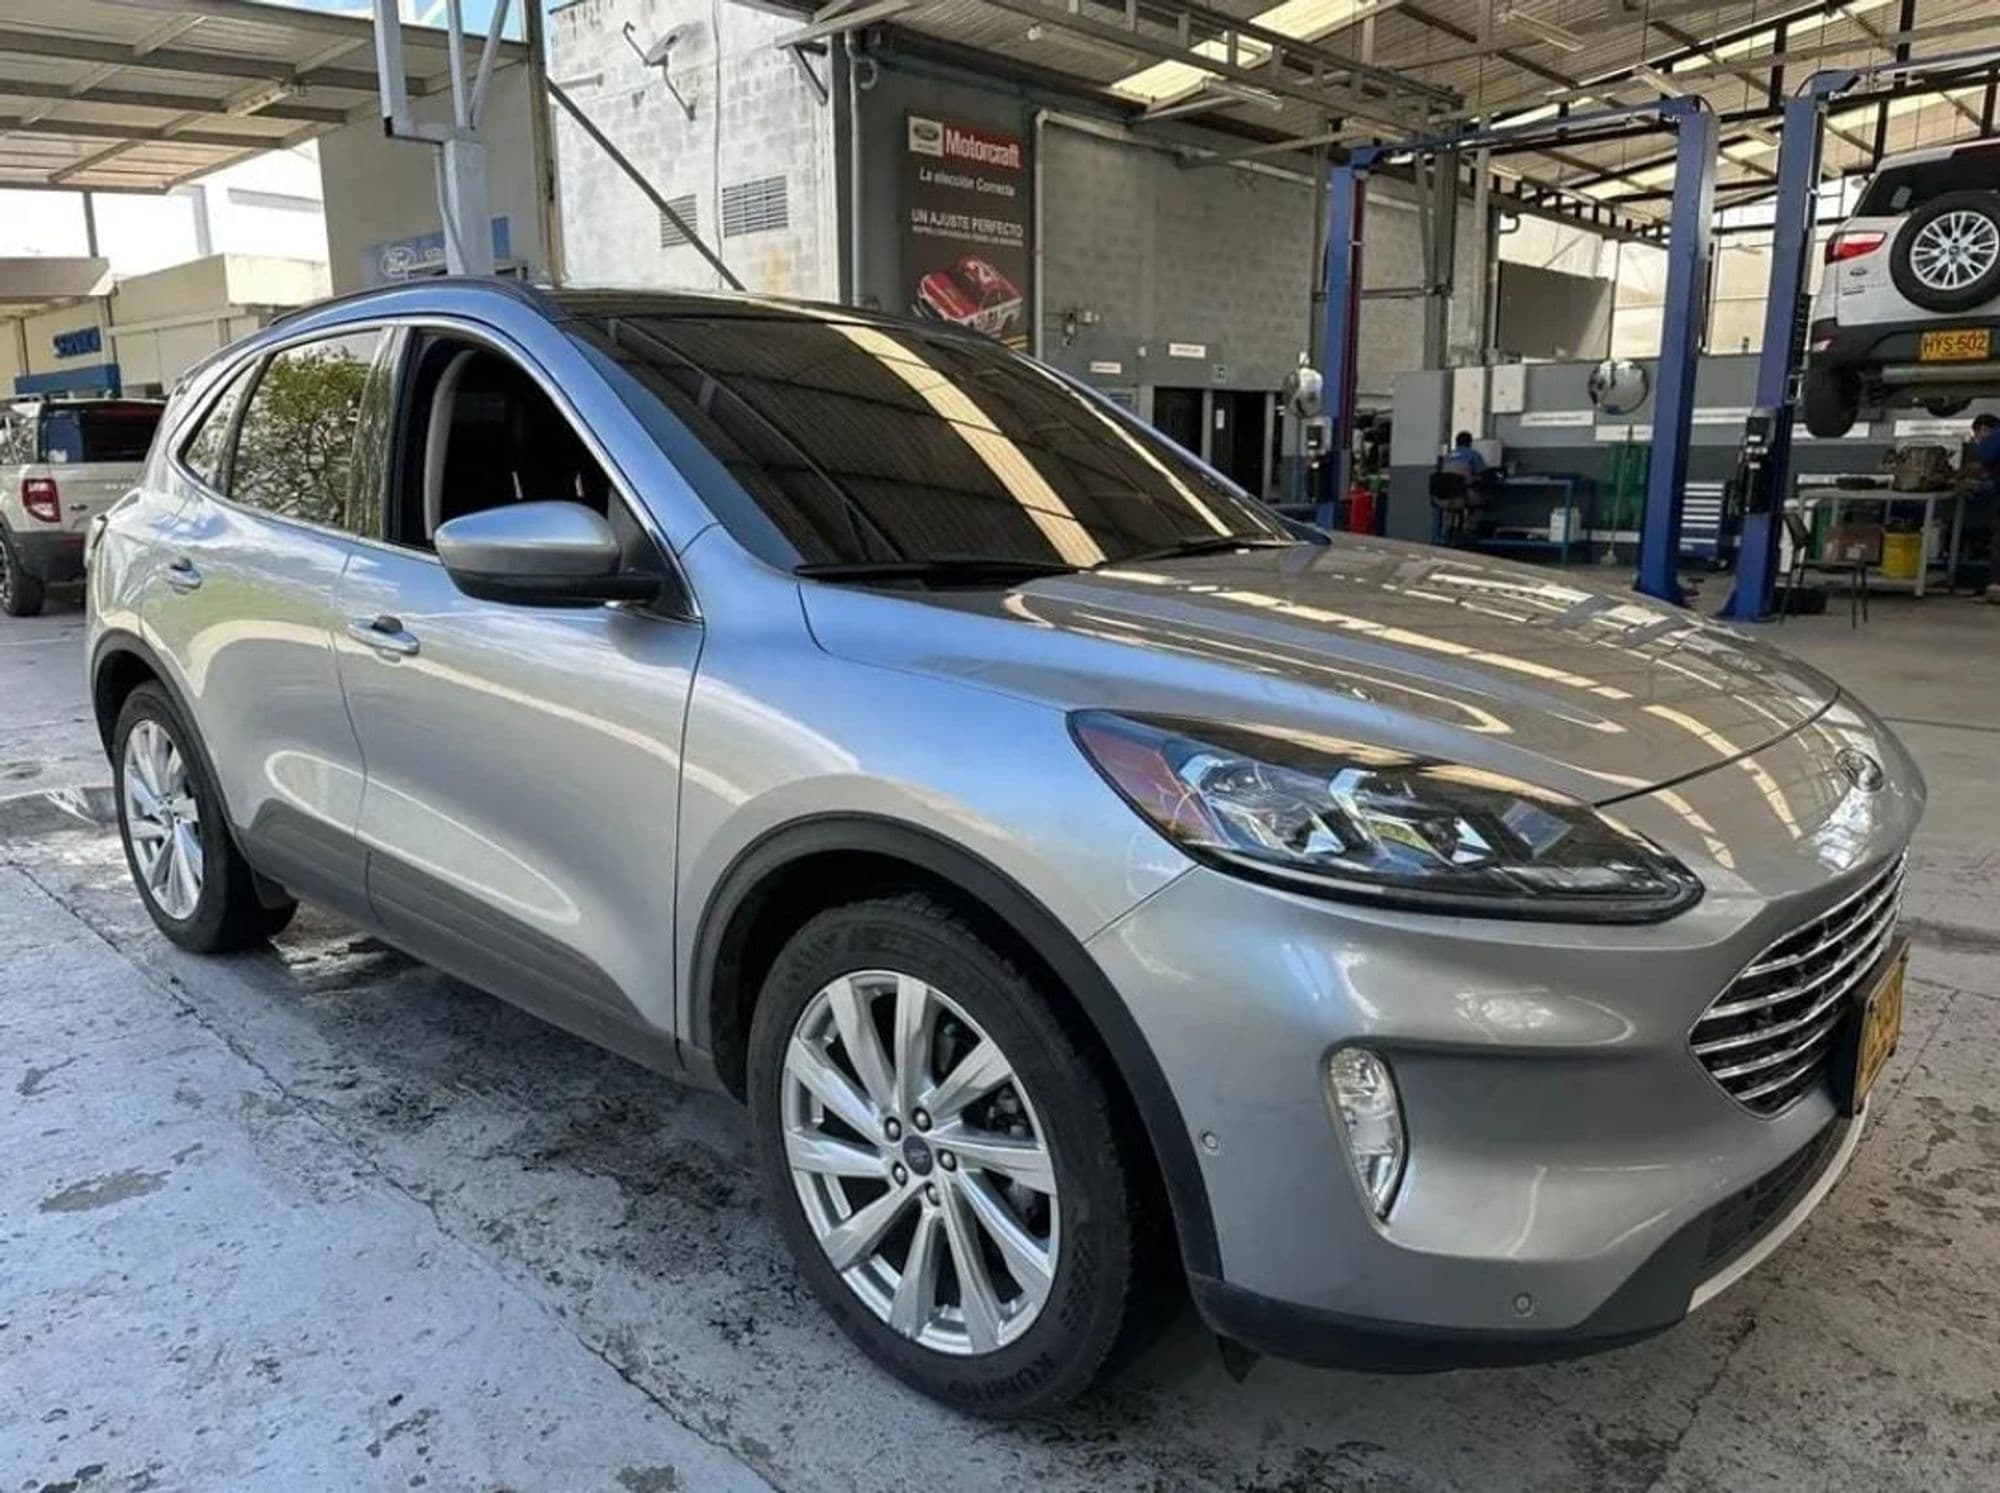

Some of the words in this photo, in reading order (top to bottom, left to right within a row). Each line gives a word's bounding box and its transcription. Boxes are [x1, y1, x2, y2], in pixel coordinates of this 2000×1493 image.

[945, 128, 1020, 168] Motorcraft
[911, 208, 927, 223] UN
[930, 211, 969, 229] AJUSTE
[971, 217, 1023, 238] PERFECTO
[947, 1351, 1056, 1400] KUMHO
